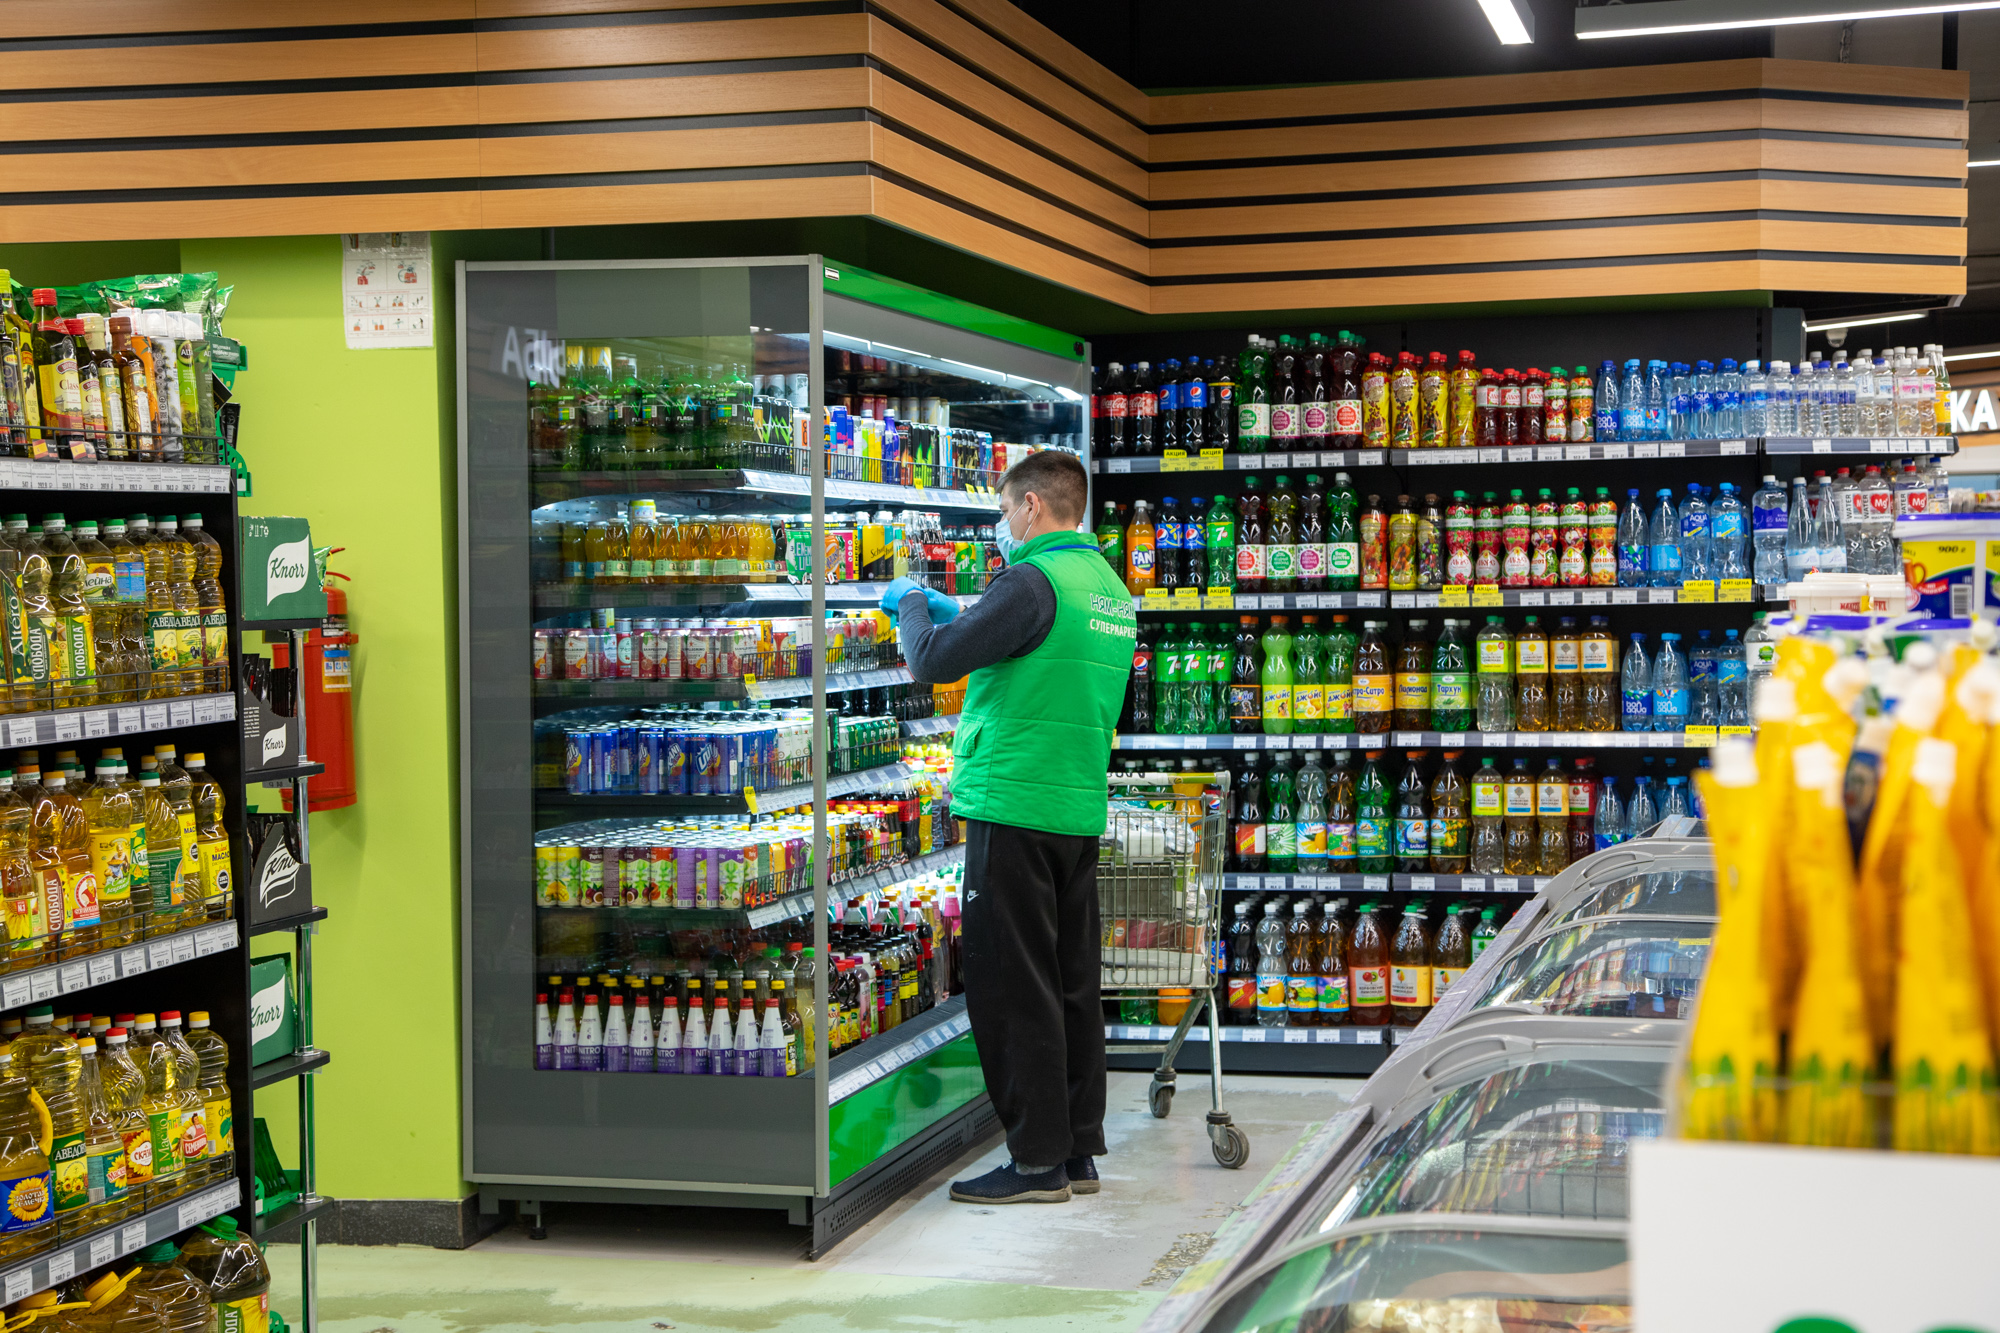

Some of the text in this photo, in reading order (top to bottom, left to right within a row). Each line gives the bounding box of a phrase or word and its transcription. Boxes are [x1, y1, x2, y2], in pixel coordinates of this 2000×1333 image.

[1874, 497, 1887, 509] Mg
[1912, 496, 1926, 508] Mg
[269, 557, 306, 579] Knorr
[9, 596, 26, 656] Altero
[29, 627, 45, 681] СЛОБОДА
[73, 625, 87, 677] СЛОБОДА
[1694, 660, 1712, 668] AQUA
[1437, 684, 1461, 695] Тархун
[1626, 706, 1647, 714] aqua
[1657, 706, 1677, 714] aqua
[264, 737, 284, 751] Knorr
[47, 879, 61, 931] СЛОБОДА
[579, 1046, 600, 1055] NITRO
[633, 1048, 654, 1056] NITRO
[158, 1118, 171, 1163] Масло
[14, 1189, 45, 1202] ЗОЛОТАЯ
[13, 1197, 46, 1208] СЕМЕЧКА
